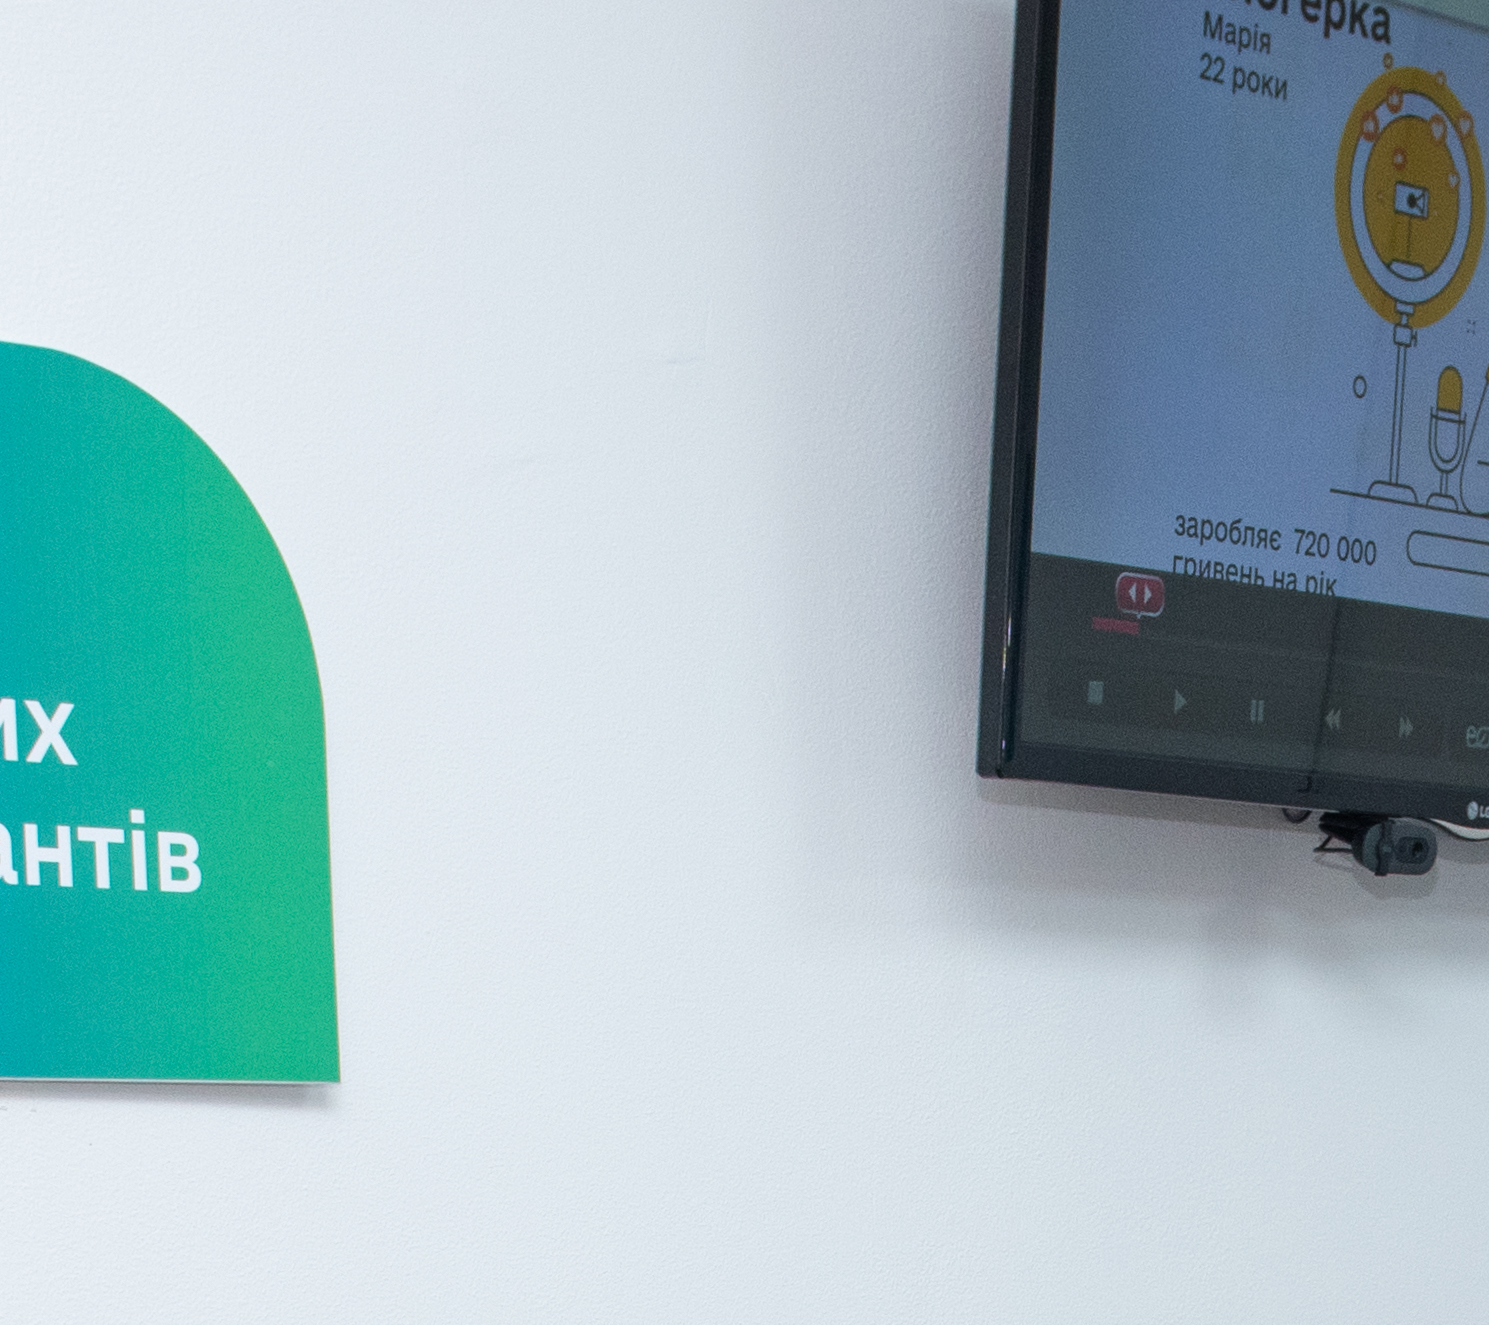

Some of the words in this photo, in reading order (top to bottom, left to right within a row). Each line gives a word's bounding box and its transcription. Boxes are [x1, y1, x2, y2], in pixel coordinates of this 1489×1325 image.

[1202, 12, 1271, 55] Марія
[1199, 52, 1224, 81] 22
[1232, 63, 1289, 101] роки
[1174, 515, 1282, 551] заробляє
[1294, 528, 1330, 558] 720
[1337, 536, 1377, 566] 000
[1172, 555, 1265, 587] гривень
[1273, 570, 1297, 591] на
[1305, 571, 1337, 597] рік
